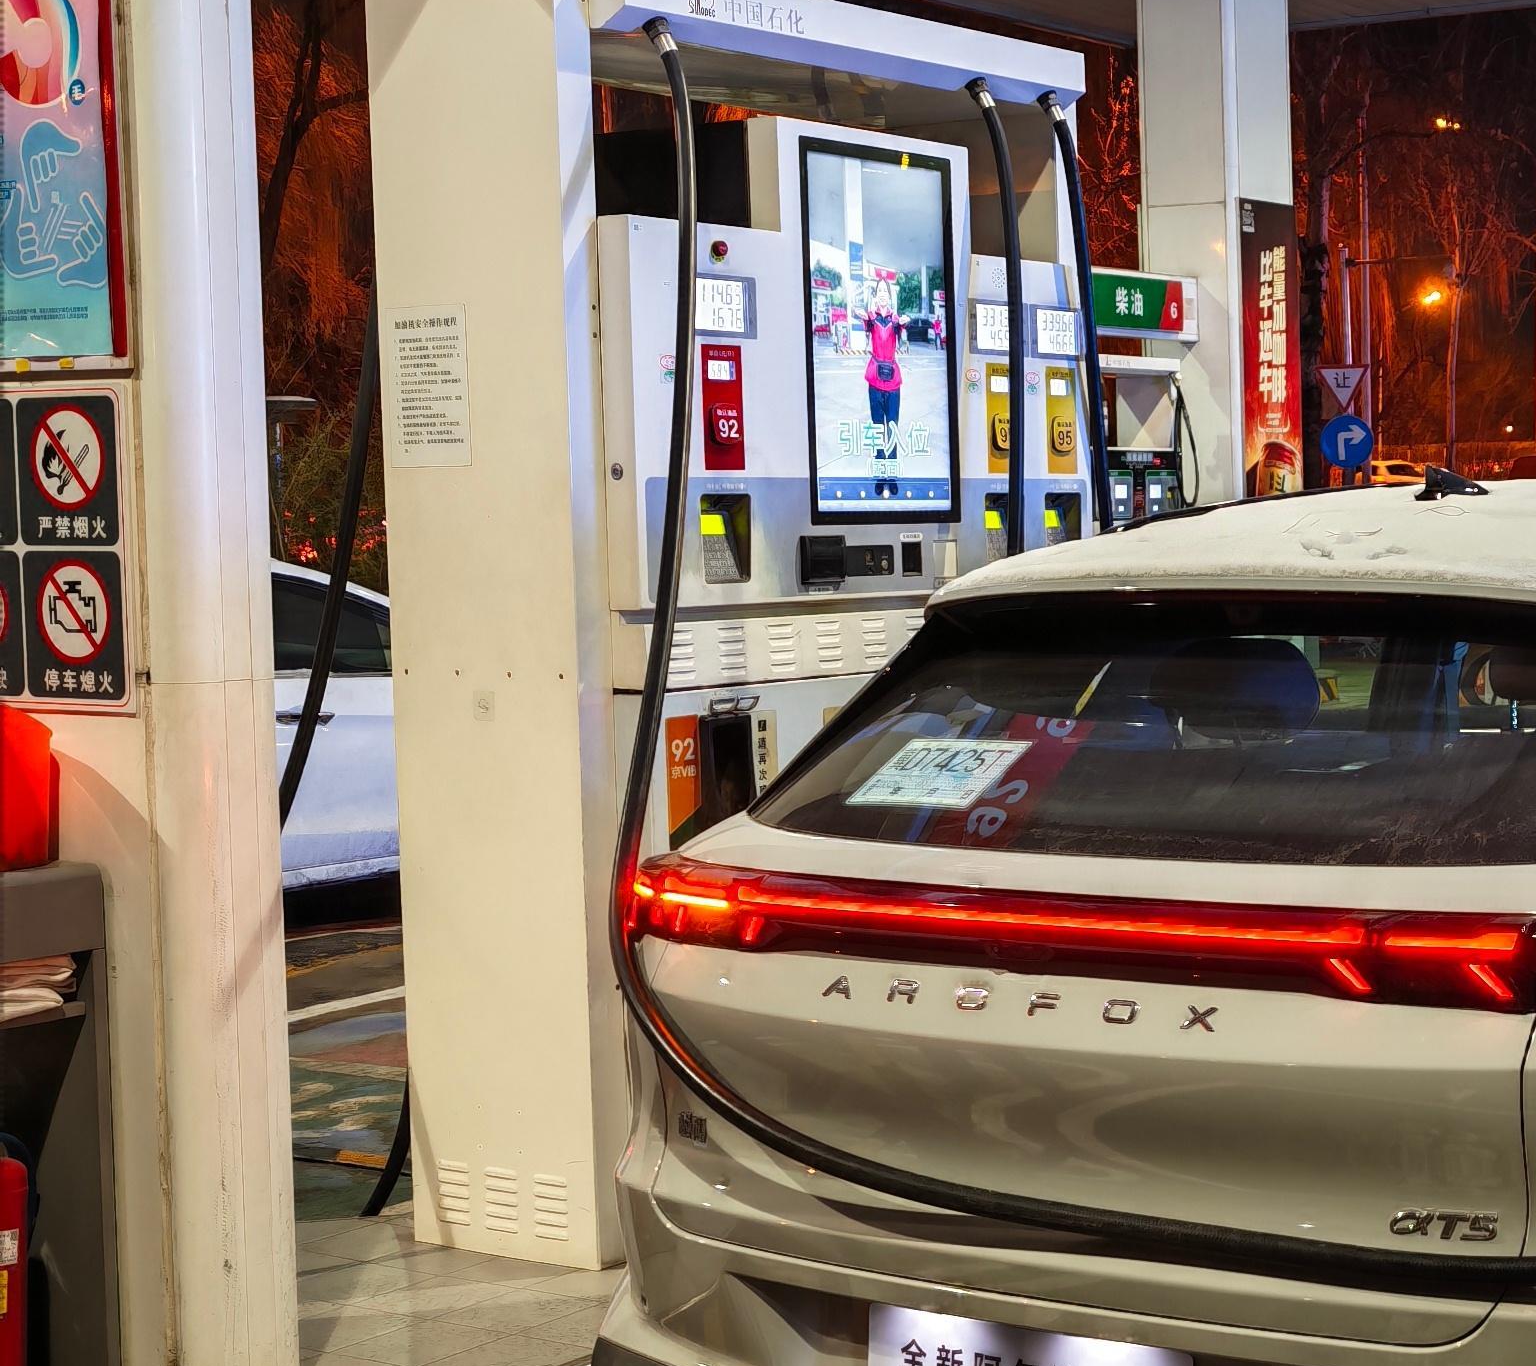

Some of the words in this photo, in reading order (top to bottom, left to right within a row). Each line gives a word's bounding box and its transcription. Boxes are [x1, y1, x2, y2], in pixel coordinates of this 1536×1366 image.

[1115, 286, 1144, 317] 柴油
[1170, 301, 1178, 319] 6
[1333, 371, 1351, 389] 让
[718, 418, 740, 438] 92
[837, 419, 932, 458] 引车入位
[1057, 430, 1073, 447] 95
[38, 516, 107, 539] 严禁烟火
[44, 668, 114, 693] 停车熄火
[671, 737, 695, 762] 92
[822, 974, 1219, 1032] ARCFOX
